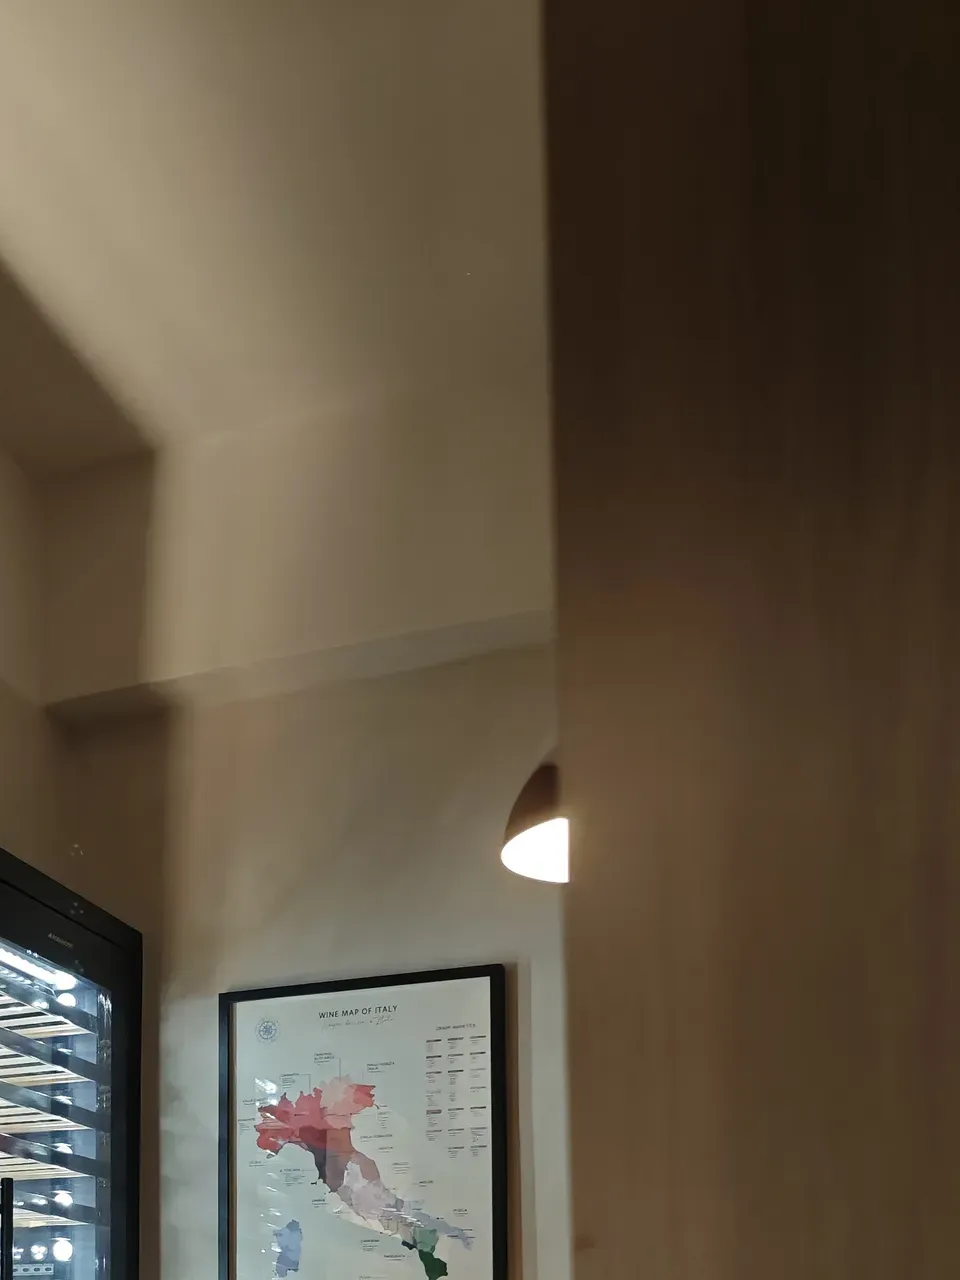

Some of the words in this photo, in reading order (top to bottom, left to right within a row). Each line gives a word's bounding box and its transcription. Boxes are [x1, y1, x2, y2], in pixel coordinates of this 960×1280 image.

[318, 1010, 339, 1019] WINE
[341, 1008, 359, 1017] MAP
[361, 1007, 372, 1015] OF
[374, 1005, 398, 1014] ITALY
